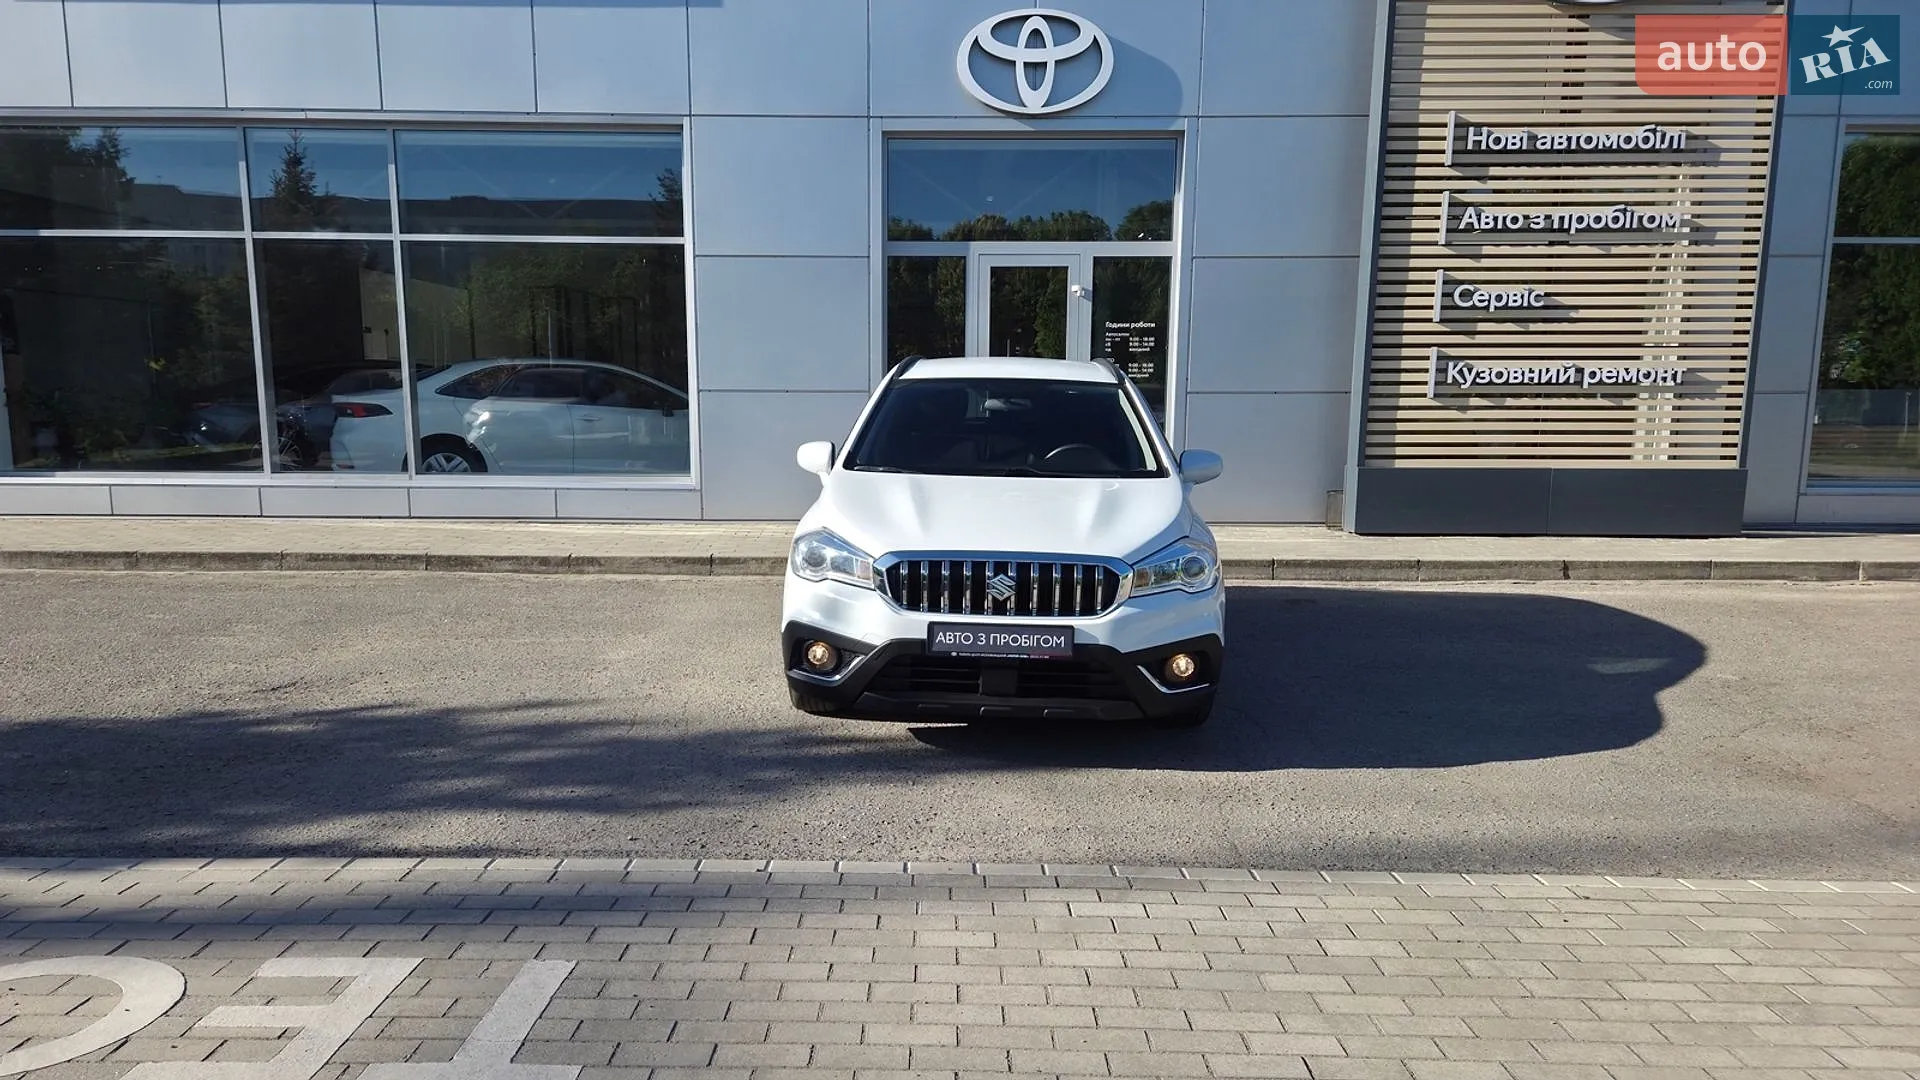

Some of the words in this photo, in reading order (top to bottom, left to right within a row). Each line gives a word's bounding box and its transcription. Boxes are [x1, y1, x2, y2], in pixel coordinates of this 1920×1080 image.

[1465, 125, 1528, 151] Нові
[1535, 124, 1687, 151] автомобілі
[1459, 206, 1523, 231] Авто
[1529, 213, 1545, 231] з
[1552, 204, 1681, 235] пробігом
[1453, 284, 1545, 312] Сервіс
[1105, 321, 1130, 329] Години
[1130, 320, 1156, 329] роботи
[1446, 361, 1576, 388] Кузовний
[1582, 366, 1687, 389] ремонт
[935, 631, 974, 645] АВТО
[990, 633, 1065, 647] ПРОБІГОМ
